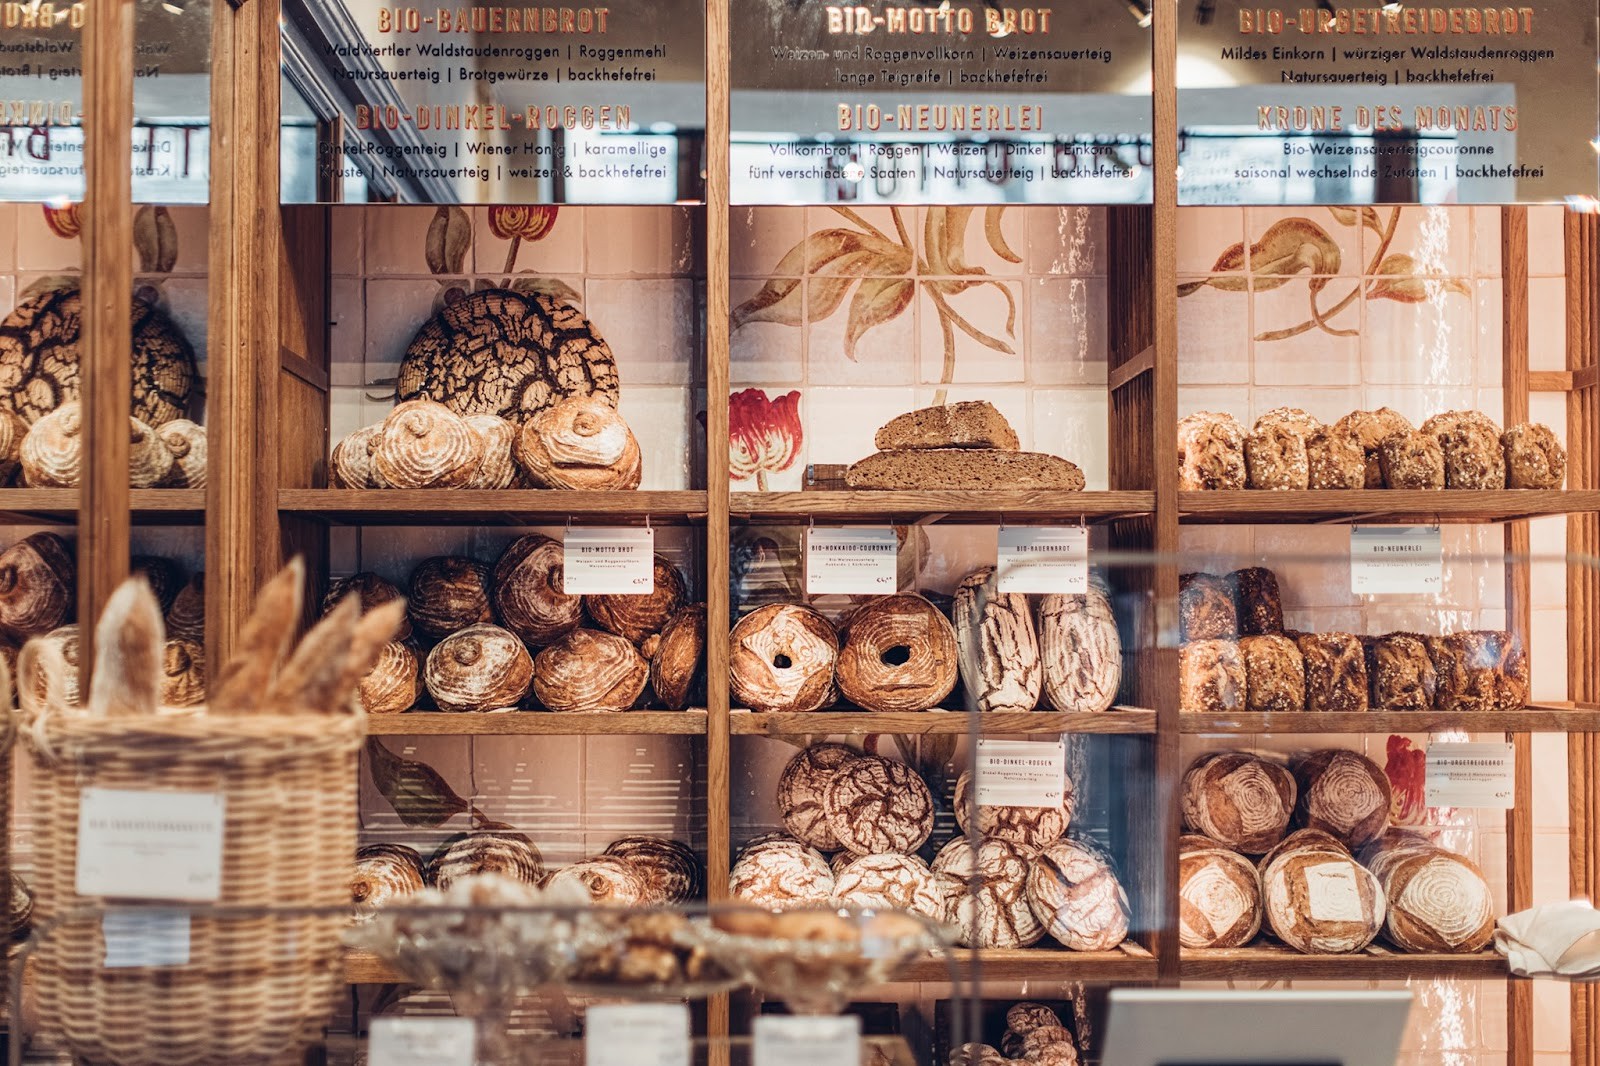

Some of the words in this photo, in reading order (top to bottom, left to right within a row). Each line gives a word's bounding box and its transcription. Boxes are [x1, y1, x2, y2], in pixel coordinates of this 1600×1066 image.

[377, 7, 610, 34] BIO-BAUERNBROT
[827, 6, 974, 35] BIO-MOTTO
[986, 7, 1052, 36] BROT
[1239, 7, 1535, 35] BIO-URGETREIDEBROT
[324, 44, 411, 58] Waldviertler
[416, 44, 560, 62] Waldstaudenroggen
[579, 44, 667, 62] Roggenmehl
[833, 46, 859, 61] und
[866, 46, 974, 64] Roggenvollkorn
[994, 46, 1113, 64] Weizensauerteig
[1221, 46, 1267, 61] Mildes
[1272, 46, 1325, 61] Einkorn
[1343, 46, 1405, 64] würziger
[1411, 46, 1555, 64] Waldstaudenroggen
[334, 67, 440, 83] Natursauerteig
[459, 66, 549, 83] Brotgewürze
[568, 66, 656, 82] backhefefrei
[836, 69, 876, 85] lange
[882, 69, 941, 85] Teigreife
[960, 69, 1048, 84] backhefefrei
[1281, 69, 1388, 85] Natursauerteig
[1406, 69, 1494, 84] backhefefrei
[356, 103, 631, 131] BIO-DINKEL-ROGGEN
[837, 104, 1044, 131] BIO-NEUNERLEI
[1257, 105, 1343, 132] KRONE
[1356, 105, 1404, 132] DES
[1415, 105, 1519, 132] MONATS
[319, 141, 447, 159] Dinkel-Roggenteig
[466, 141, 518, 156] Wiener
[523, 141, 566, 159] Honig
[584, 141, 667, 159] karamellige
[769, 142, 853, 157] Vollkornbrot
[868, 143, 920, 160] Roggen
[937, 142, 988, 157] Weizen
[1006, 142, 1046, 157] Dinkel
[1063, 142, 1113, 157] Einkorn
[1283, 142, 1494, 159] Bio-Weizensauerteigcouronne
[319, 165, 364, 179] Kruste
[382, 165, 490, 182] Natursauerteig
[563, 165, 573, 179] &
[578, 165, 667, 179] backhefefrei
[748, 165, 775, 179] fünf
[777, 165, 864, 179] verschiedee
[869, 165, 916, 179] Saaten
[934, 165, 1034, 182] Natursauerteig
[1051, 165, 1135, 180] backhefefrei
[1234, 165, 1291, 179] saisonal
[1296, 165, 1378, 179] wechselnde
[1384, 165, 1437, 179] Zutaten
[1456, 165, 1544, 179] backhefefrei
